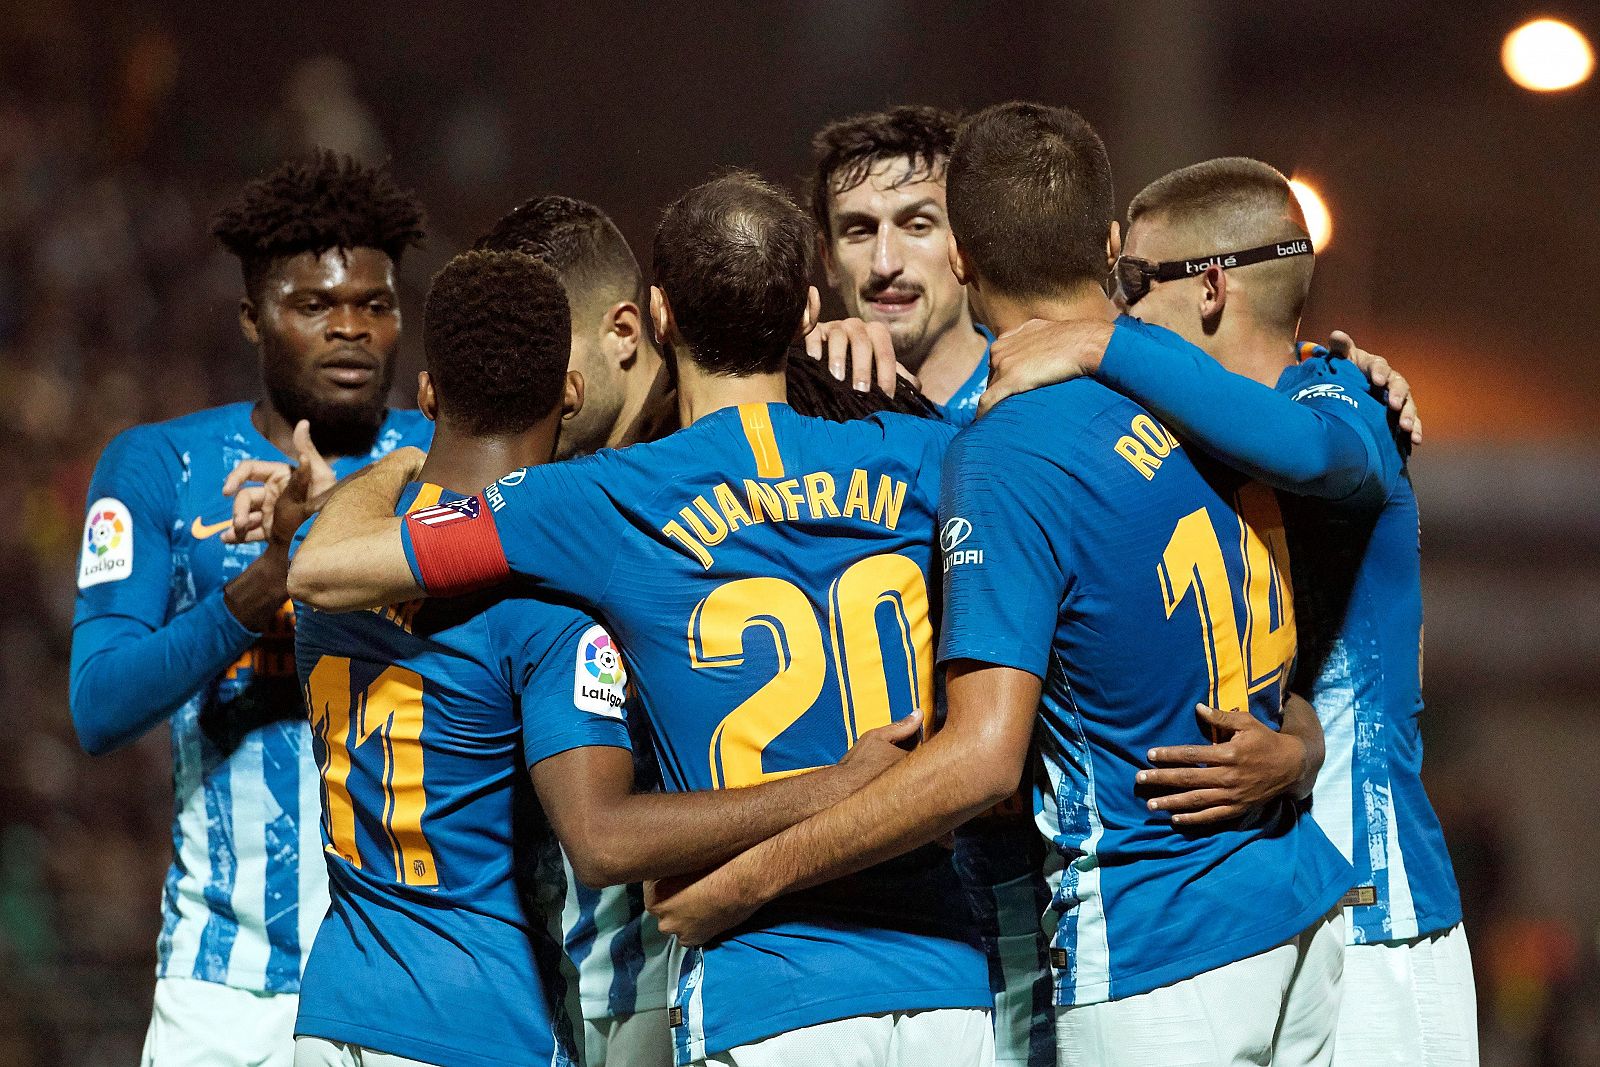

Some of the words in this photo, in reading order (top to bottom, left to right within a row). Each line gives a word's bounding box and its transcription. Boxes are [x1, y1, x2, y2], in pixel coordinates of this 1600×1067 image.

[1277, 242, 1307, 256] bollé
[84, 558, 125, 575] LaLiga
[662, 468, 907, 570] JUANFRAN
[1157, 482, 1298, 713] 14
[582, 685, 622, 707] LaLiga
[687, 553, 933, 790] 20
[304, 653, 439, 886] 11
